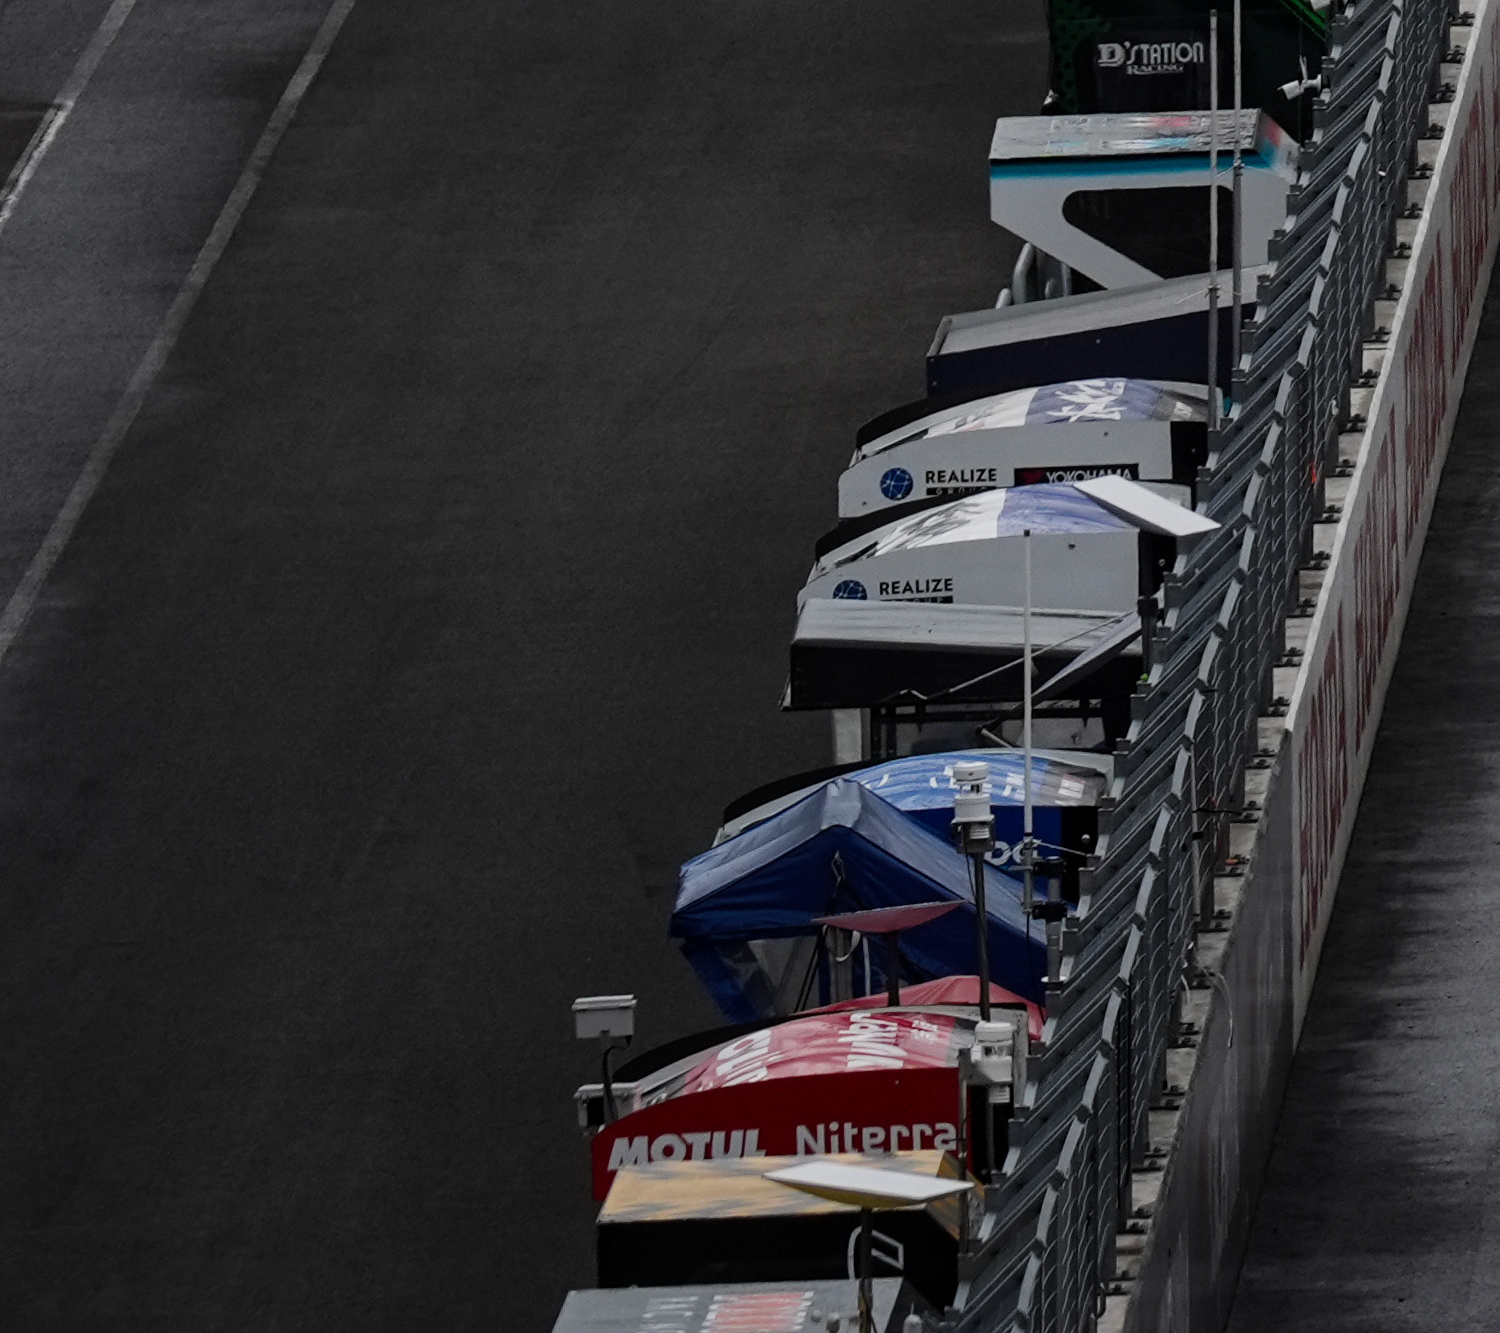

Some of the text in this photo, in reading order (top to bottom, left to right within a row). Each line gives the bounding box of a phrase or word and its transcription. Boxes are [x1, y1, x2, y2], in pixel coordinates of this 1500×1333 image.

[1097, 40, 1205, 68] D'STATION
[926, 468, 997, 484] REALIZE
[879, 578, 954, 596] REALIZE
[1299, 600, 1348, 972] HONDA
[606, 1122, 958, 1172] MOTUL Niterra
